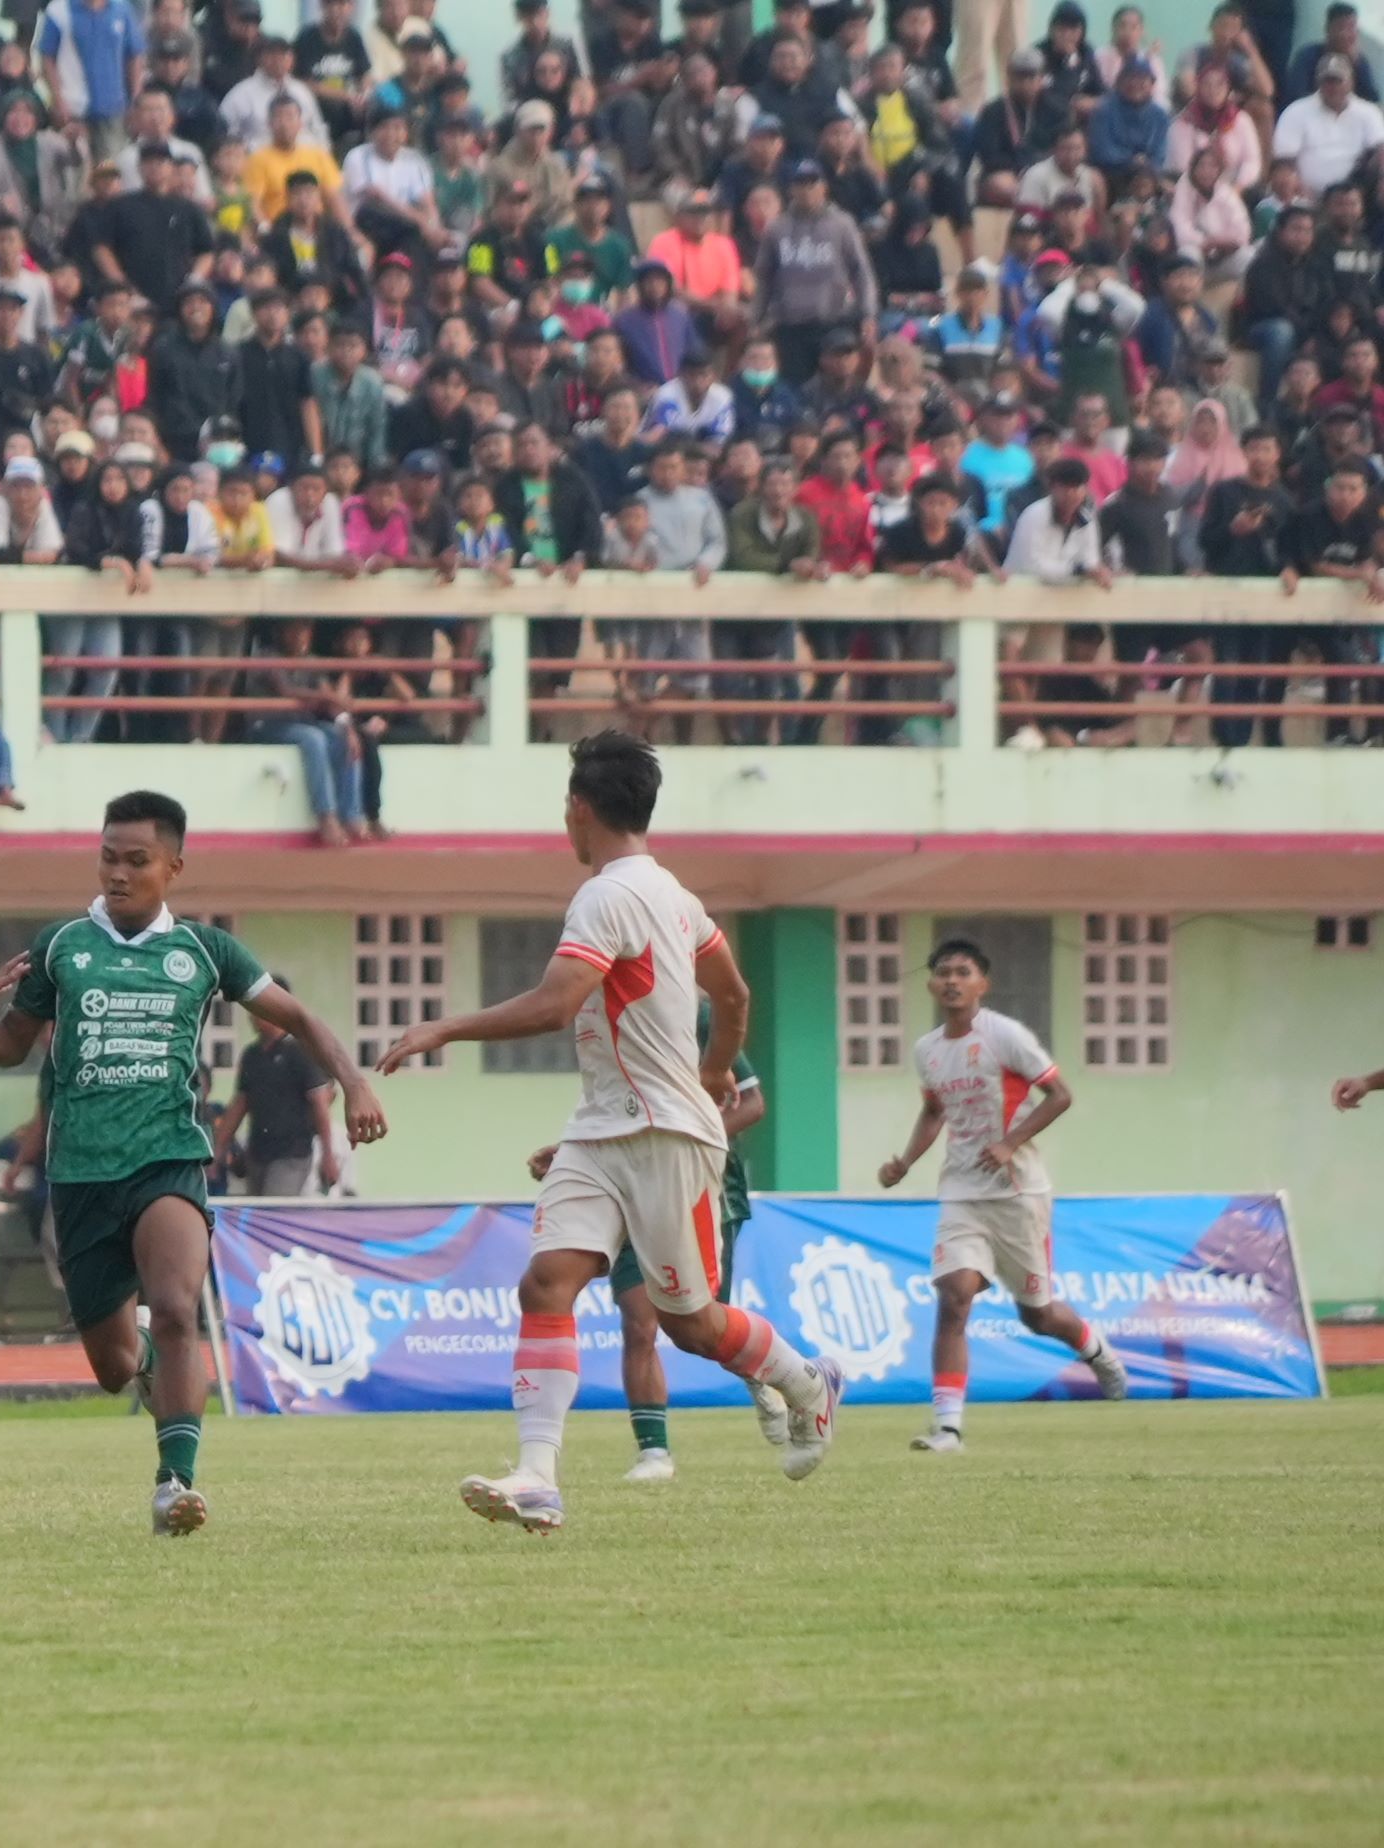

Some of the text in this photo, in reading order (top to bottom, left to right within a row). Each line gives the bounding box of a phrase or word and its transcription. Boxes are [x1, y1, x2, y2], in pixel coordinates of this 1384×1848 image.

[98, 1060, 169, 1079] madani
[662, 1265, 680, 1291] 3
[1090, 1271, 1161, 1311] JAYA
[1165, 1271, 1273, 1305] UTAMA
[424, 1286, 522, 1328] BONJ
